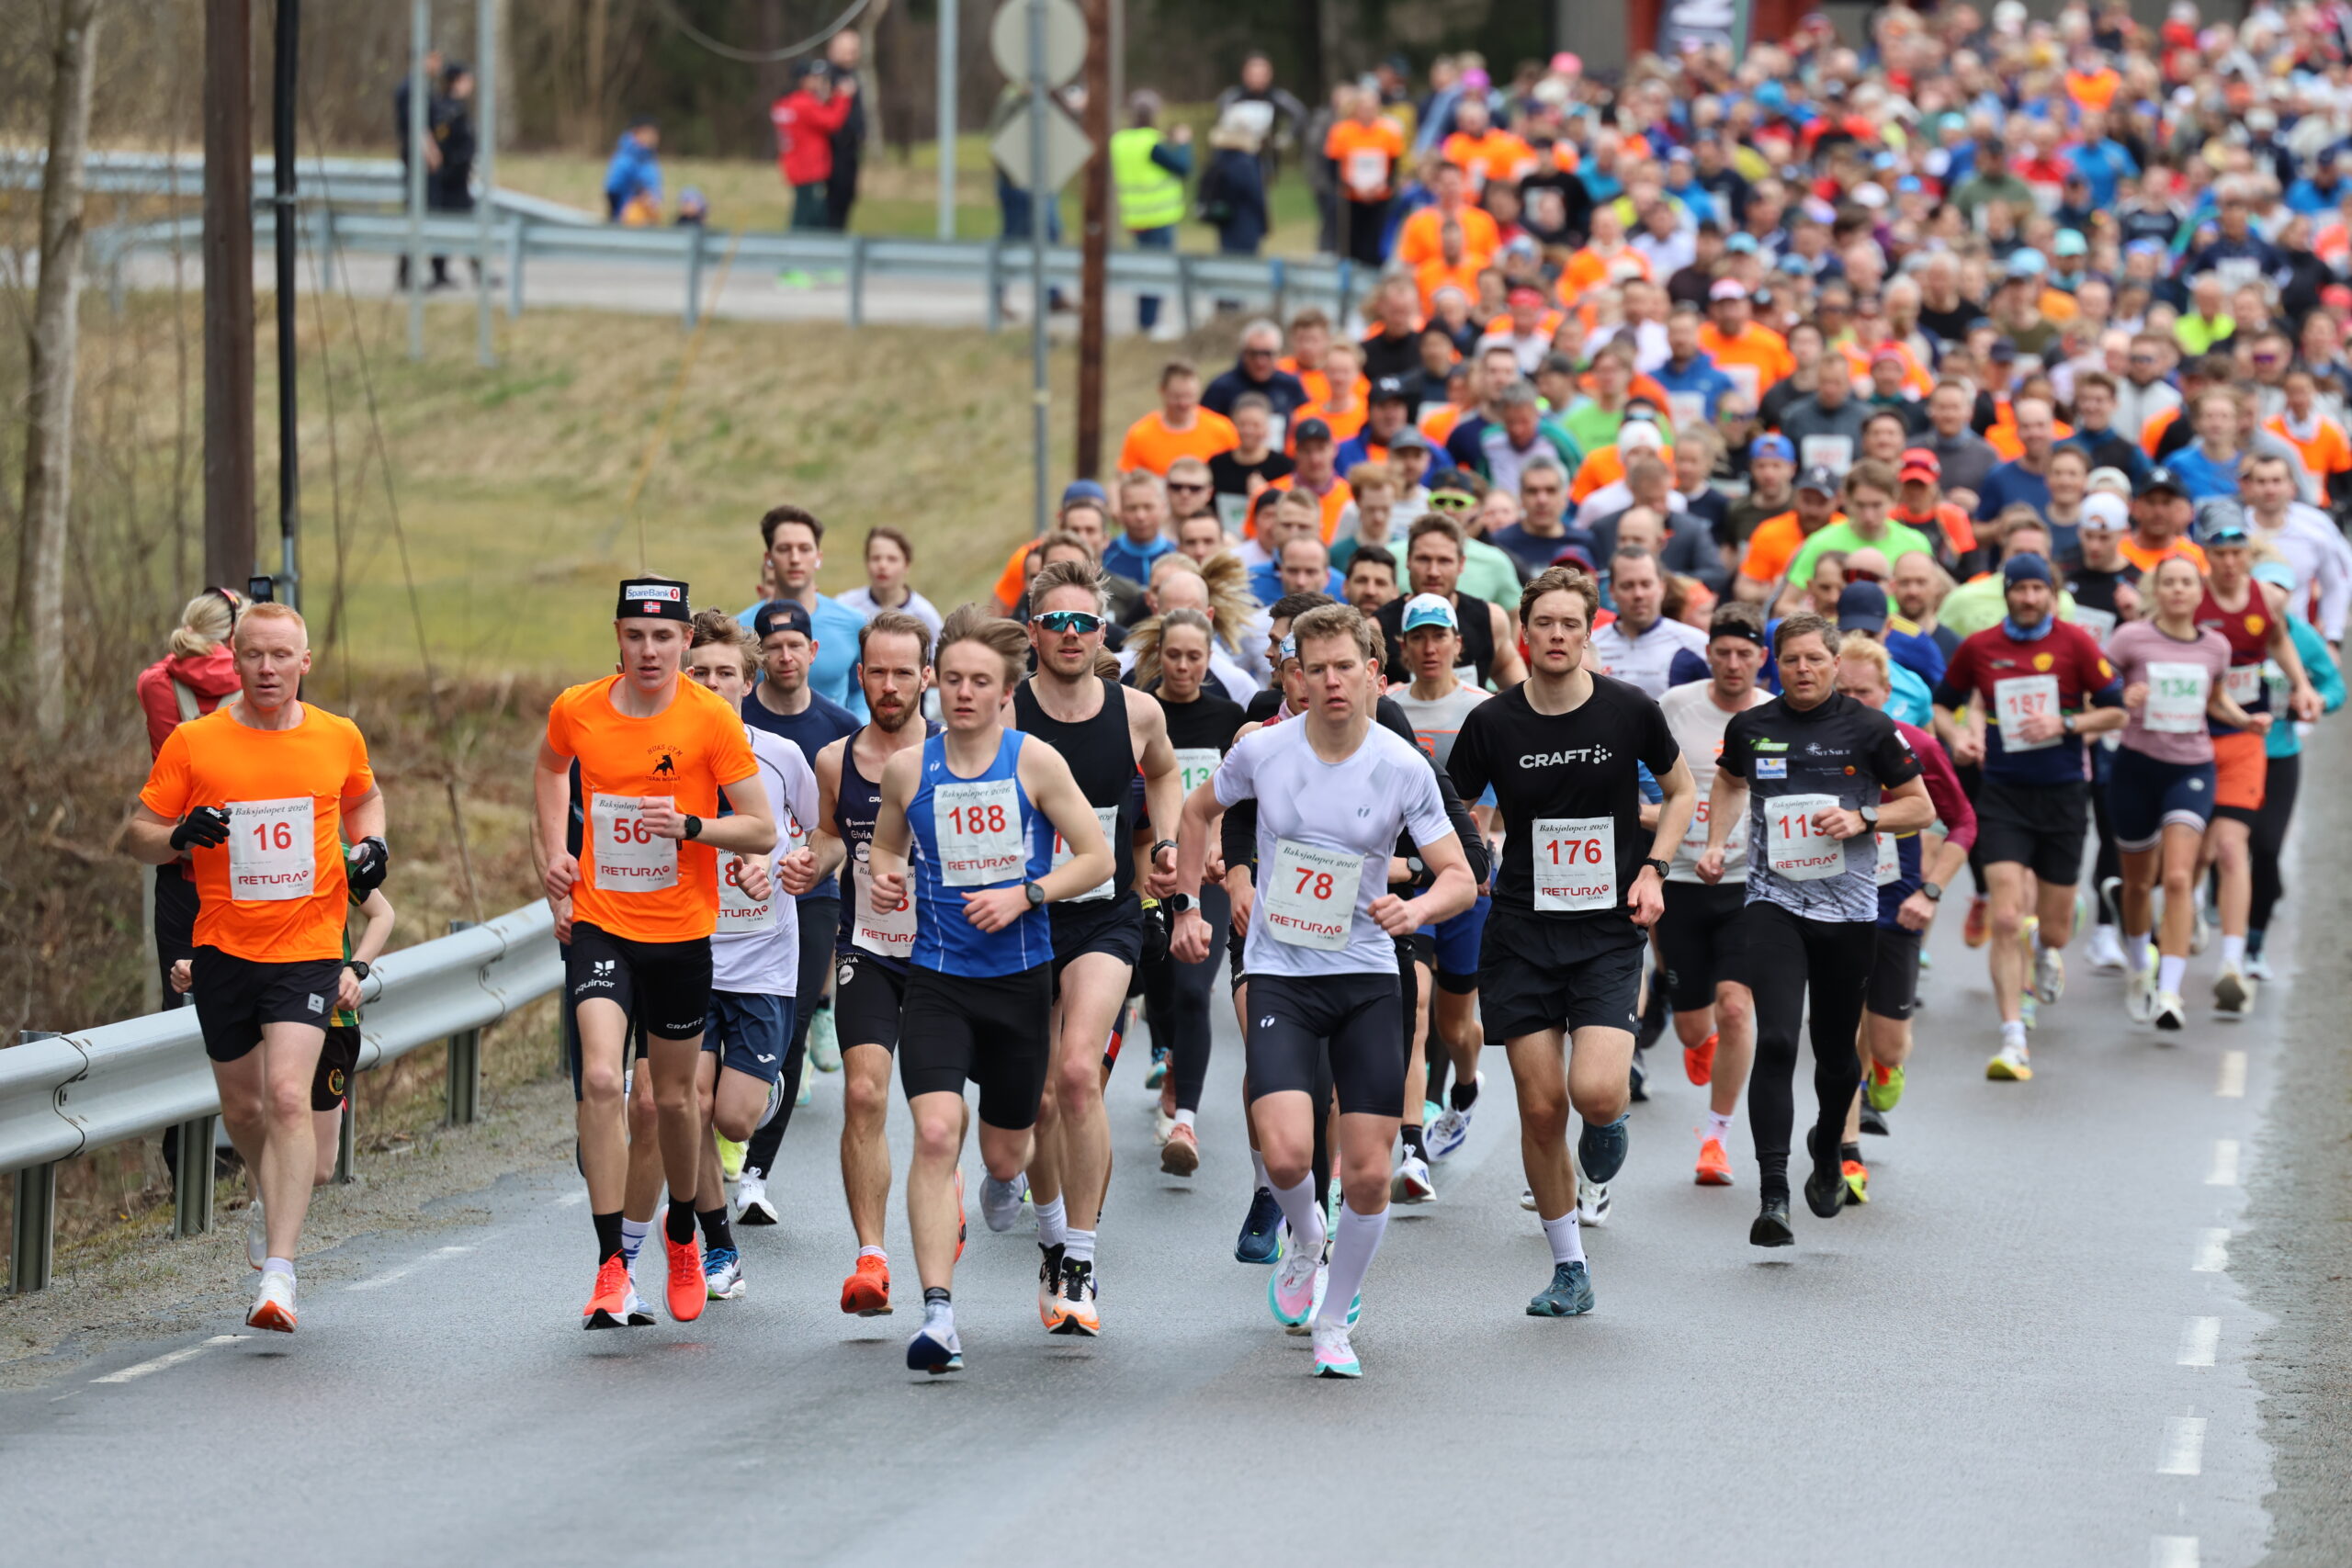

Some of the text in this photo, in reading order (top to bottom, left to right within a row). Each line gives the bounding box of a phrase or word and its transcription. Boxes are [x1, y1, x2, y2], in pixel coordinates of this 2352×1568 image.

[628, 588, 669, 598] SpareBank
[1519, 748, 1592, 769] CRAFT
[288, 803, 310, 813] 2026
[948, 804, 1006, 835] 188
[614, 818, 651, 844] 56
[1589, 823, 1610, 831] 2026
[253, 821, 292, 851] 16
[1546, 838, 1602, 865] 176
[948, 856, 1011, 871] RETURA
[1775, 856, 1833, 870] RETURA
[602, 865, 663, 876] RETURA
[239, 873, 303, 886] RETURA
[1295, 866, 1334, 900] 78
[1542, 886, 1602, 897] RETURA
[718, 908, 763, 919] TURA
[1270, 912, 1335, 936] RETURA
[666, 1020, 699, 1030] CRAFT
